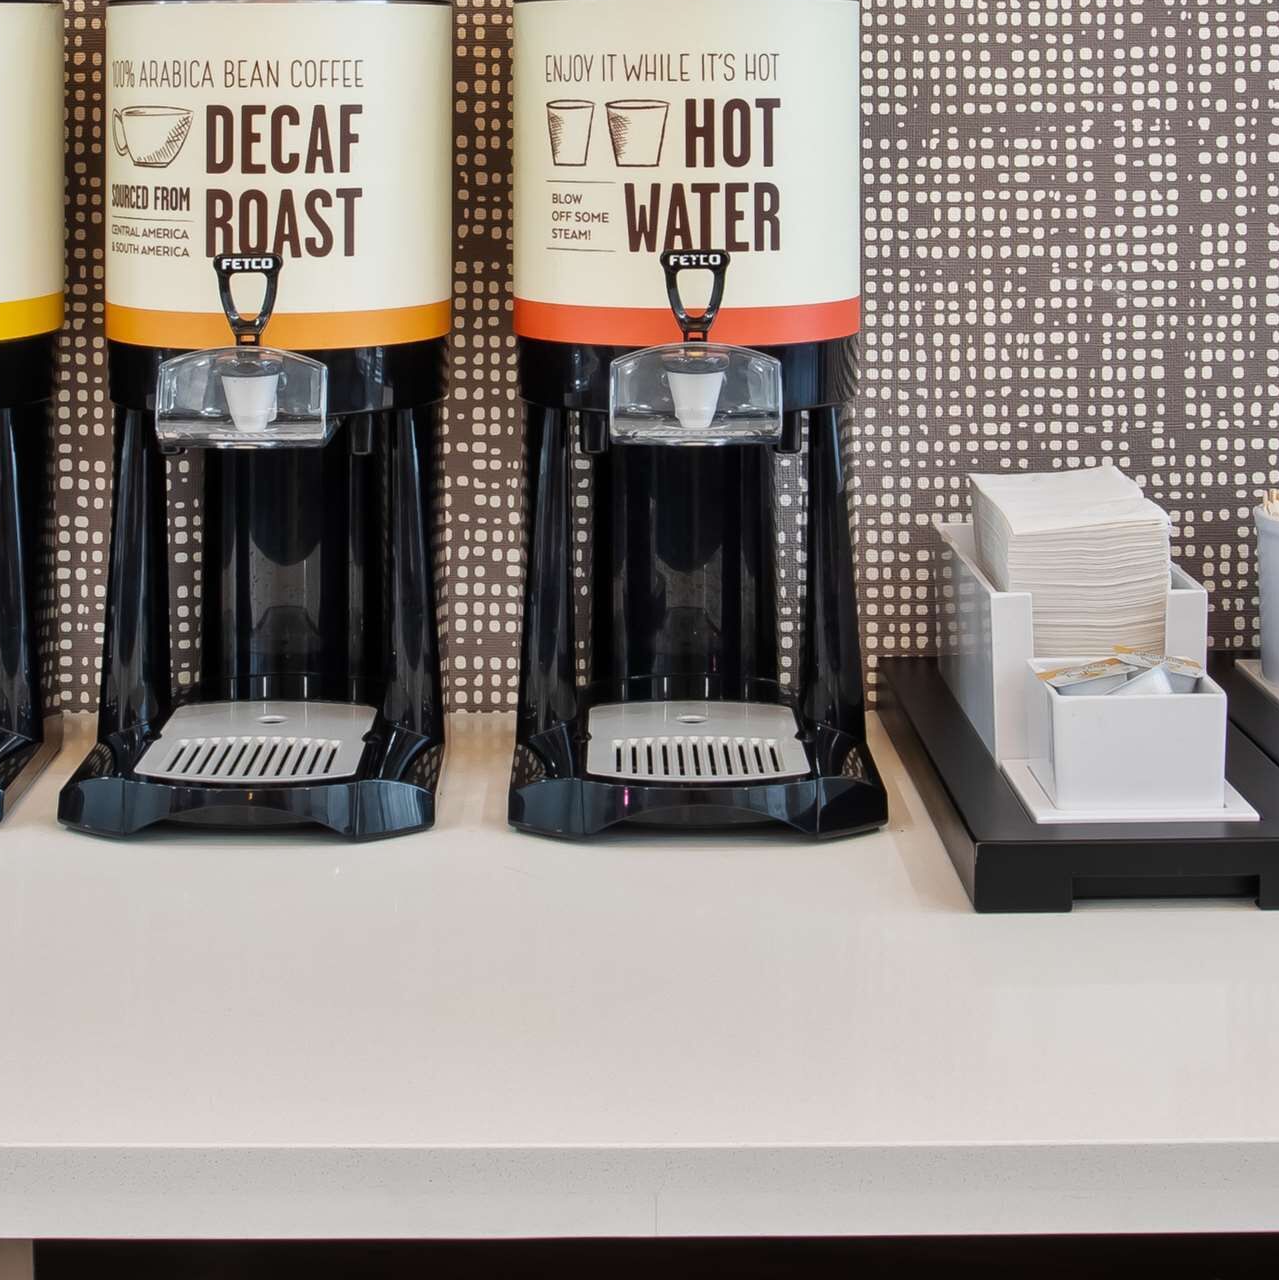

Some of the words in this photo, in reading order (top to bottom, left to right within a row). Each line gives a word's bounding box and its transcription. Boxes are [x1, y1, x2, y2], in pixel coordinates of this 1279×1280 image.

[139, 59, 215, 88] ARABICA
[224, 59, 280, 88] BEAN
[290, 59, 365, 88] COFFEE
[545, 53, 594, 82] ENJOY
[602, 53, 618, 82] IT
[623, 53, 691, 82] WHILE
[701, 52, 736, 82] IT'S
[745, 53, 780, 82] HOT
[206, 103, 363, 175] DECAF
[685, 97, 781, 169] HOT
[111, 183, 149, 210] SOURCED
[153, 186, 191, 212] FROM
[551, 193, 583, 205] BLOW
[205, 187, 363, 259] ROAST
[551, 210, 572, 223] OFF
[575, 211, 609, 224] SOME
[624, 182, 781, 252] WATER
[142, 227, 190, 240] AMERICA
[551, 228, 592, 241] STEAM!
[116, 241, 139, 255] SOUTH
[141, 245, 191, 258] AMERICA
[669, 253, 721, 266] FETCO
[221, 257, 273, 270] FETCO
